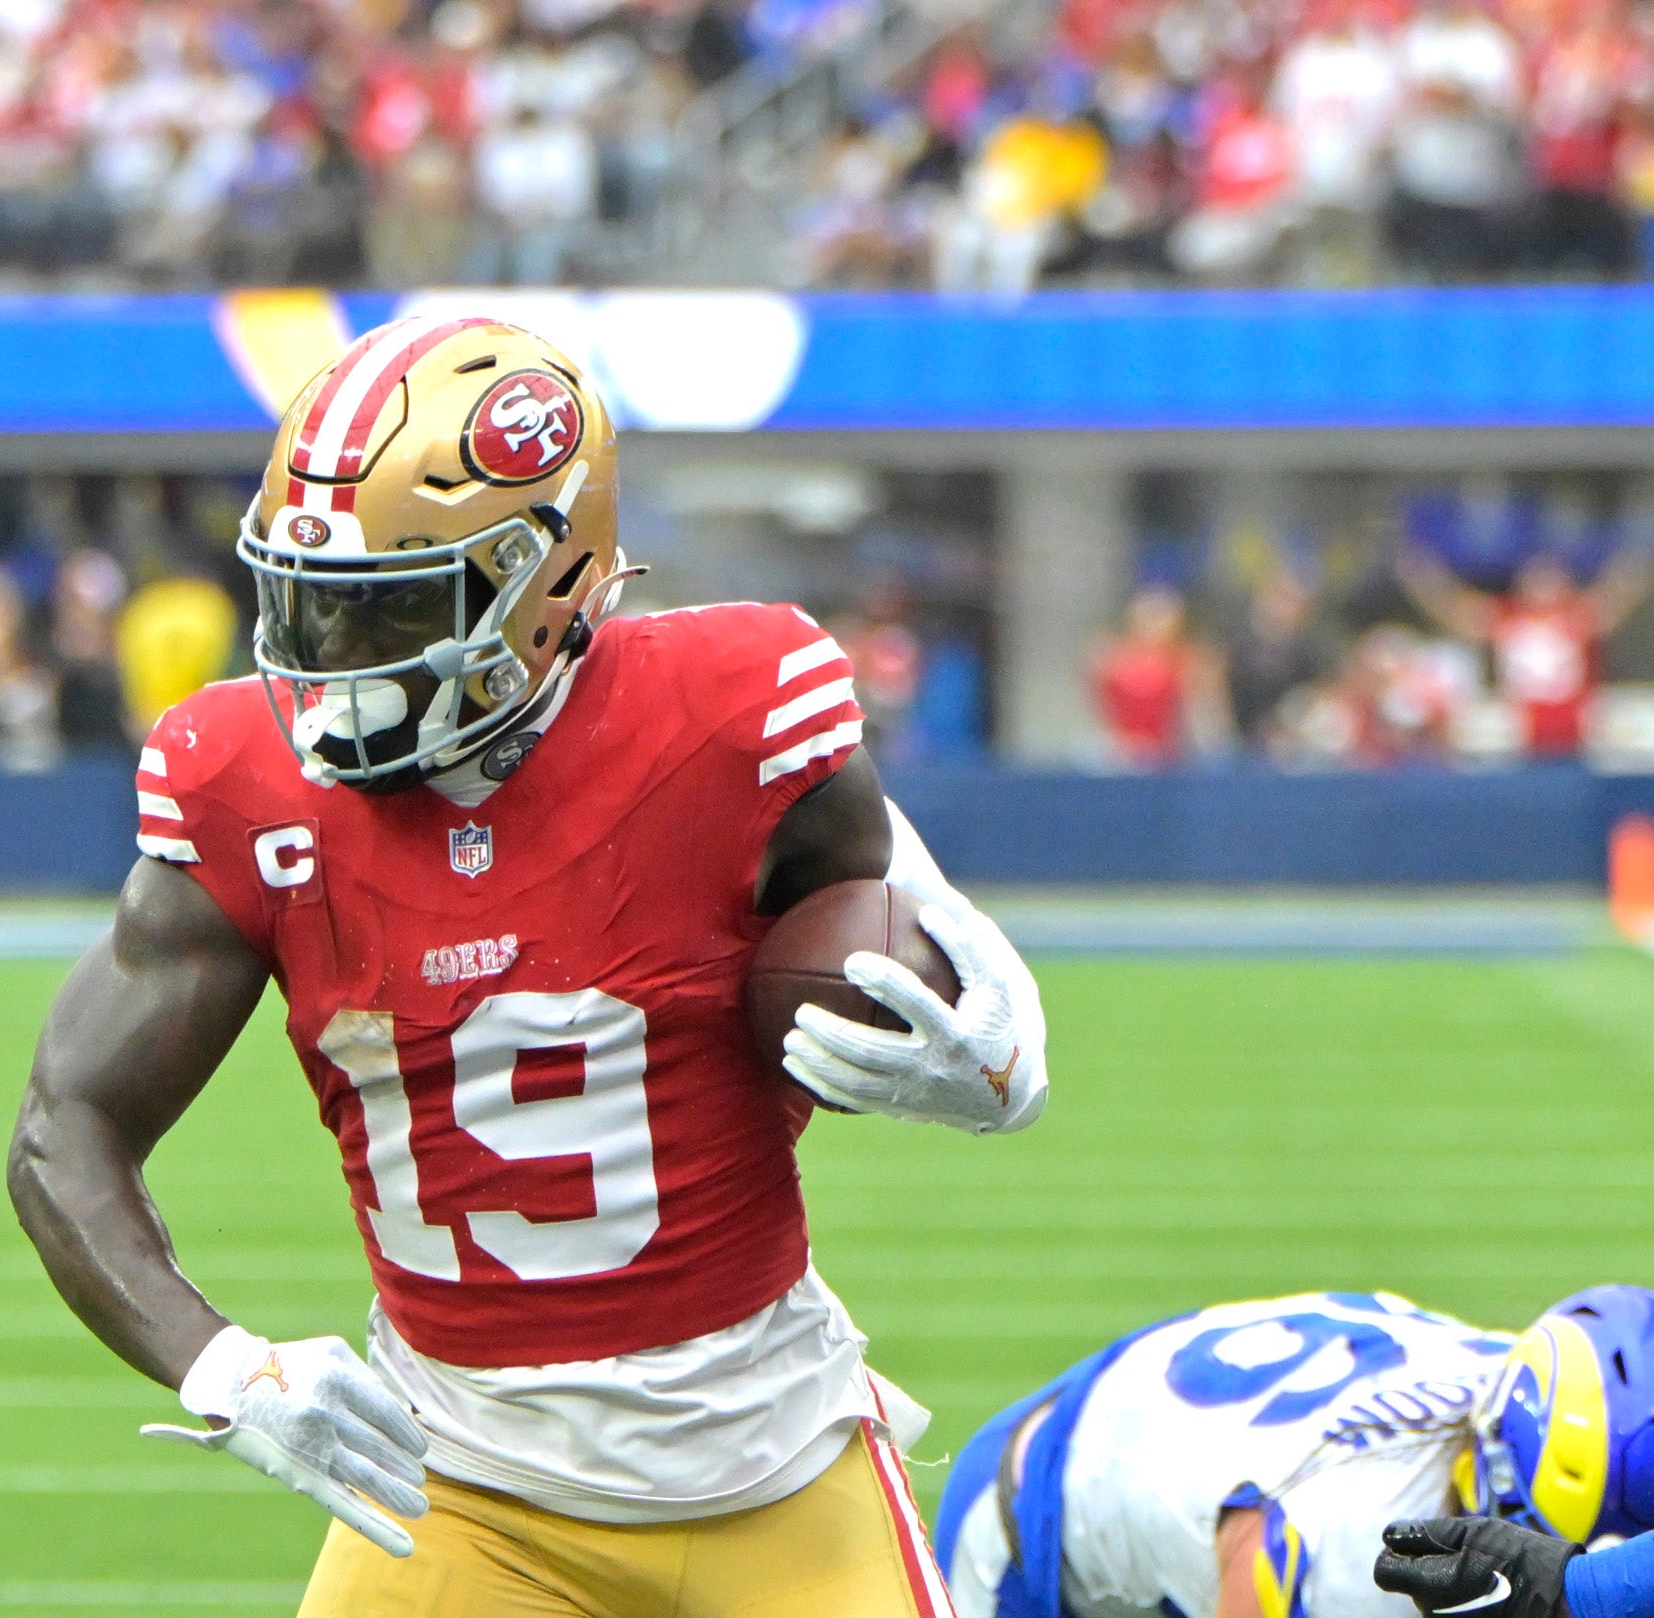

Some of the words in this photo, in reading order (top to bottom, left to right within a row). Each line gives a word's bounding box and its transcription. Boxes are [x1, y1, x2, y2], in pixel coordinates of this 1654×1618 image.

[490, 382, 572, 468] SF
[297, 519, 321, 544] SF
[255, 826, 315, 888] C
[457, 846, 487, 869] NFL
[421, 934, 519, 986] 49ERS
[317, 987, 661, 1282] 19
